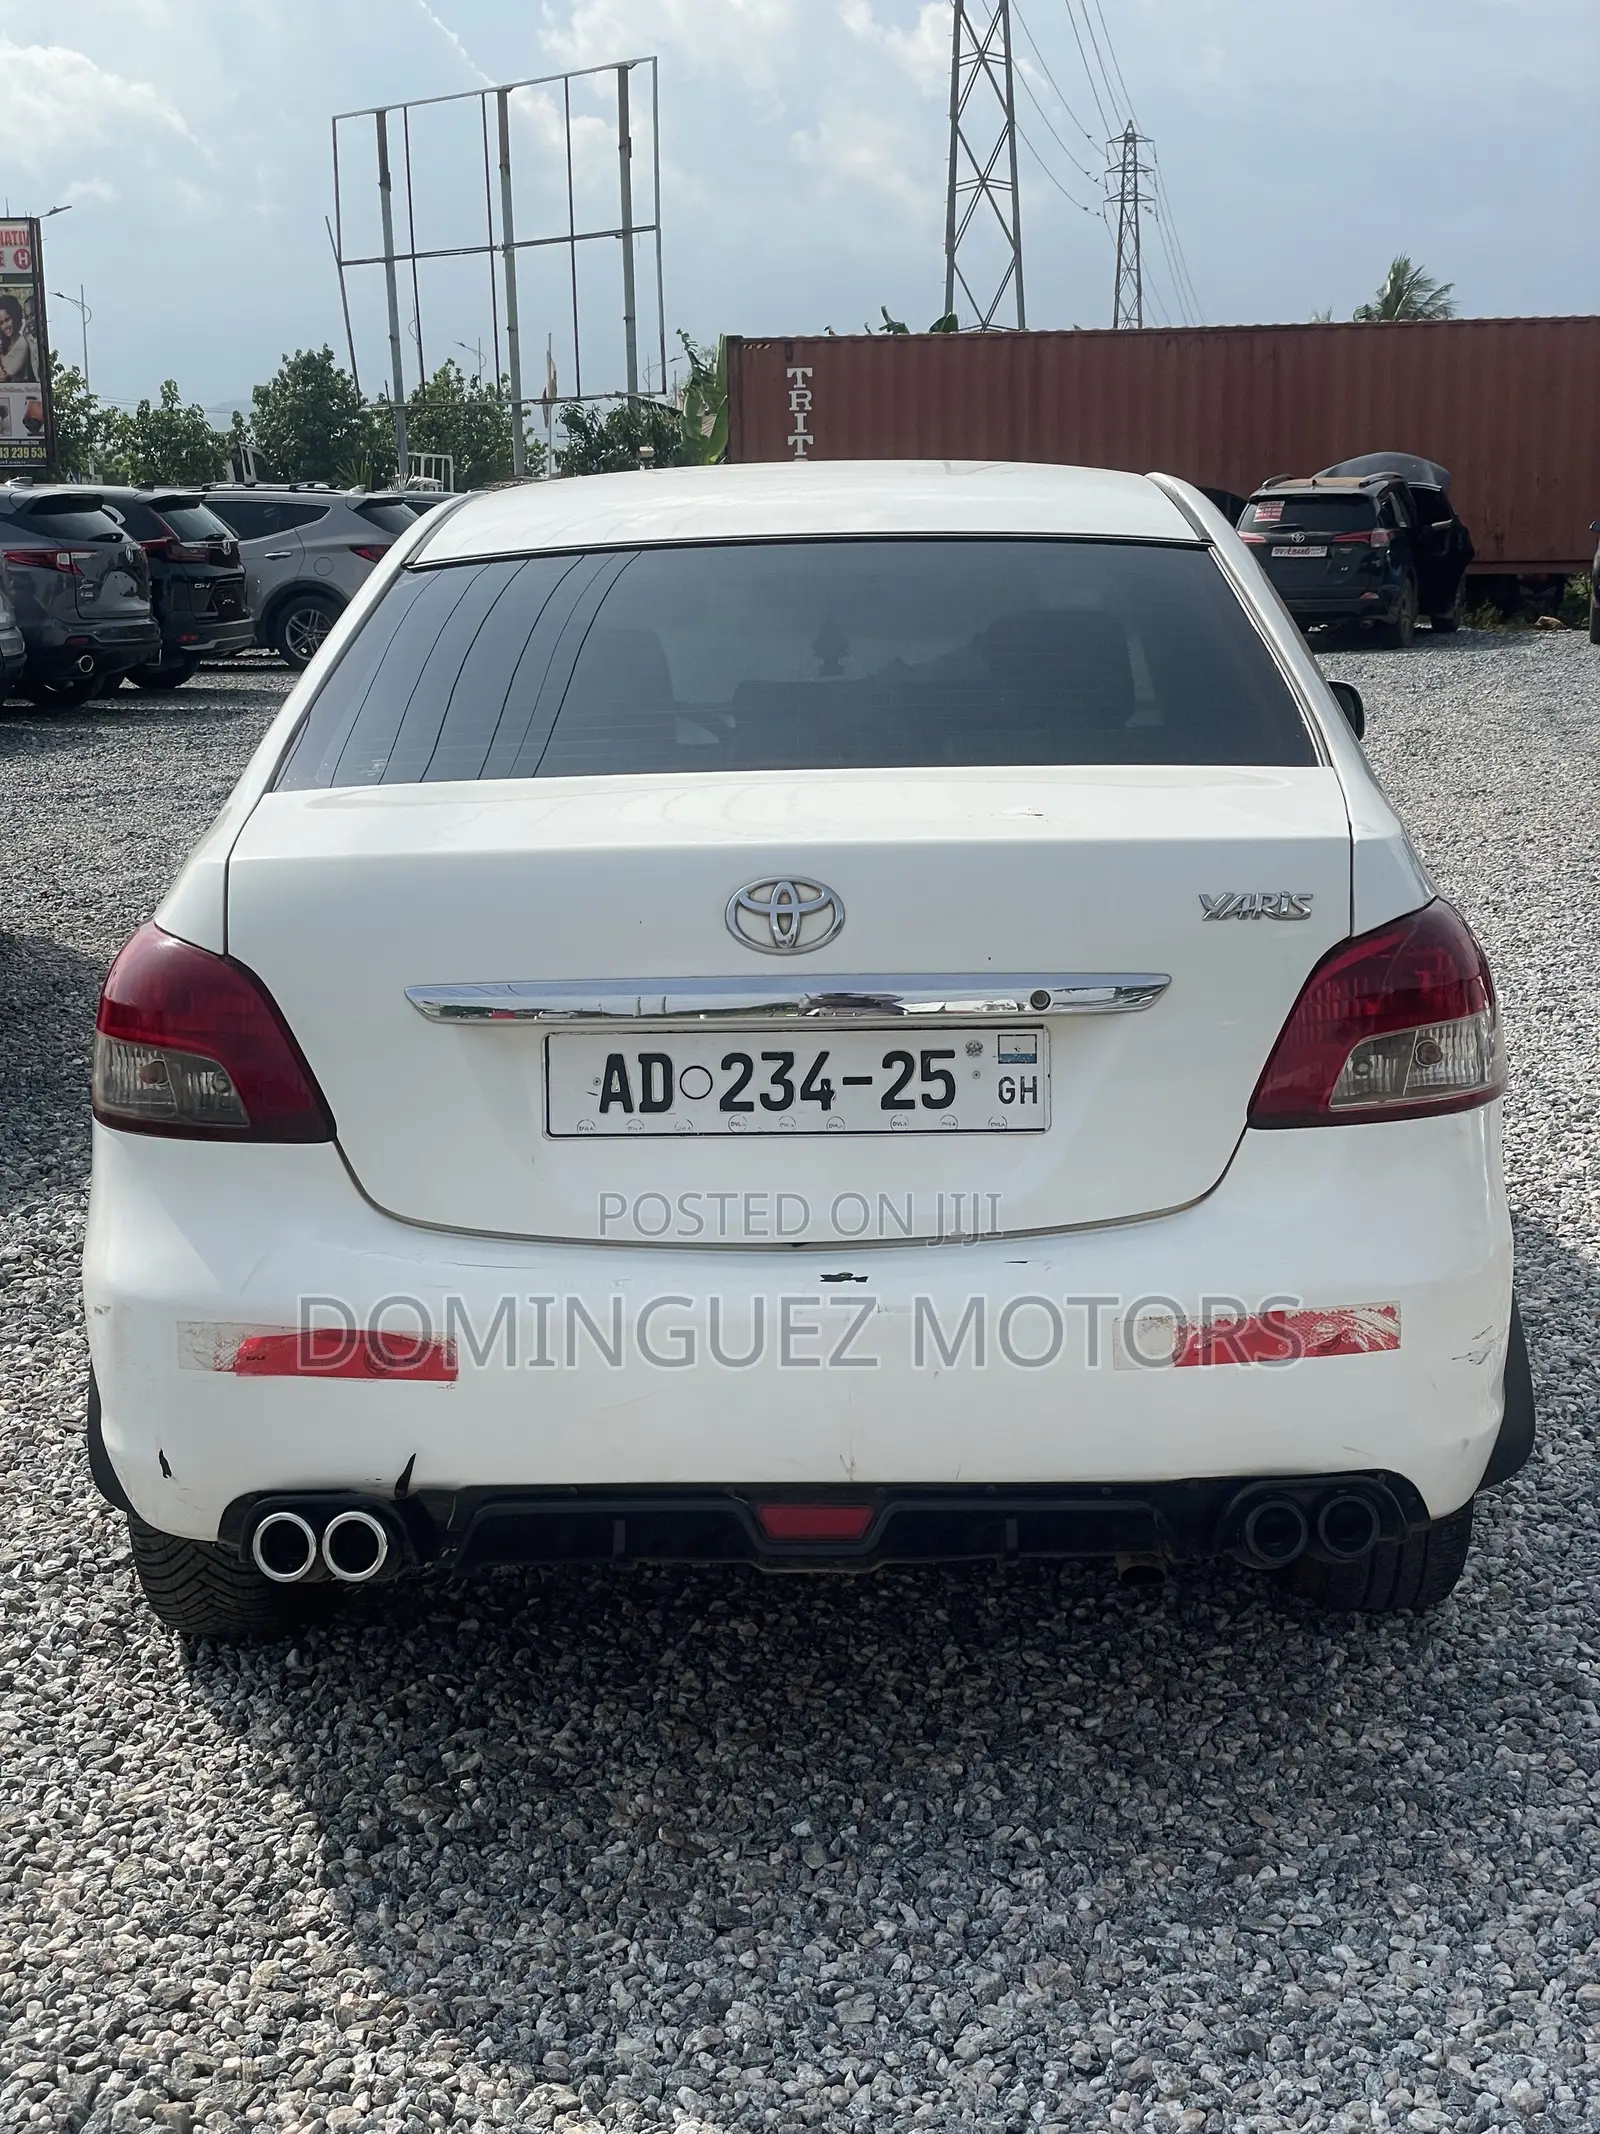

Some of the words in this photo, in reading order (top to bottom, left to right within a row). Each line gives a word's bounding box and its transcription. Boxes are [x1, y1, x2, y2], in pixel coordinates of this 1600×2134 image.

[787, 368, 814, 462] TRIT
[11, 447, 29, 459] 239
[599, 1053, 673, 1113] AD
[719, 1050, 956, 1112] 234-25
[998, 1076, 1037, 1104] GH
